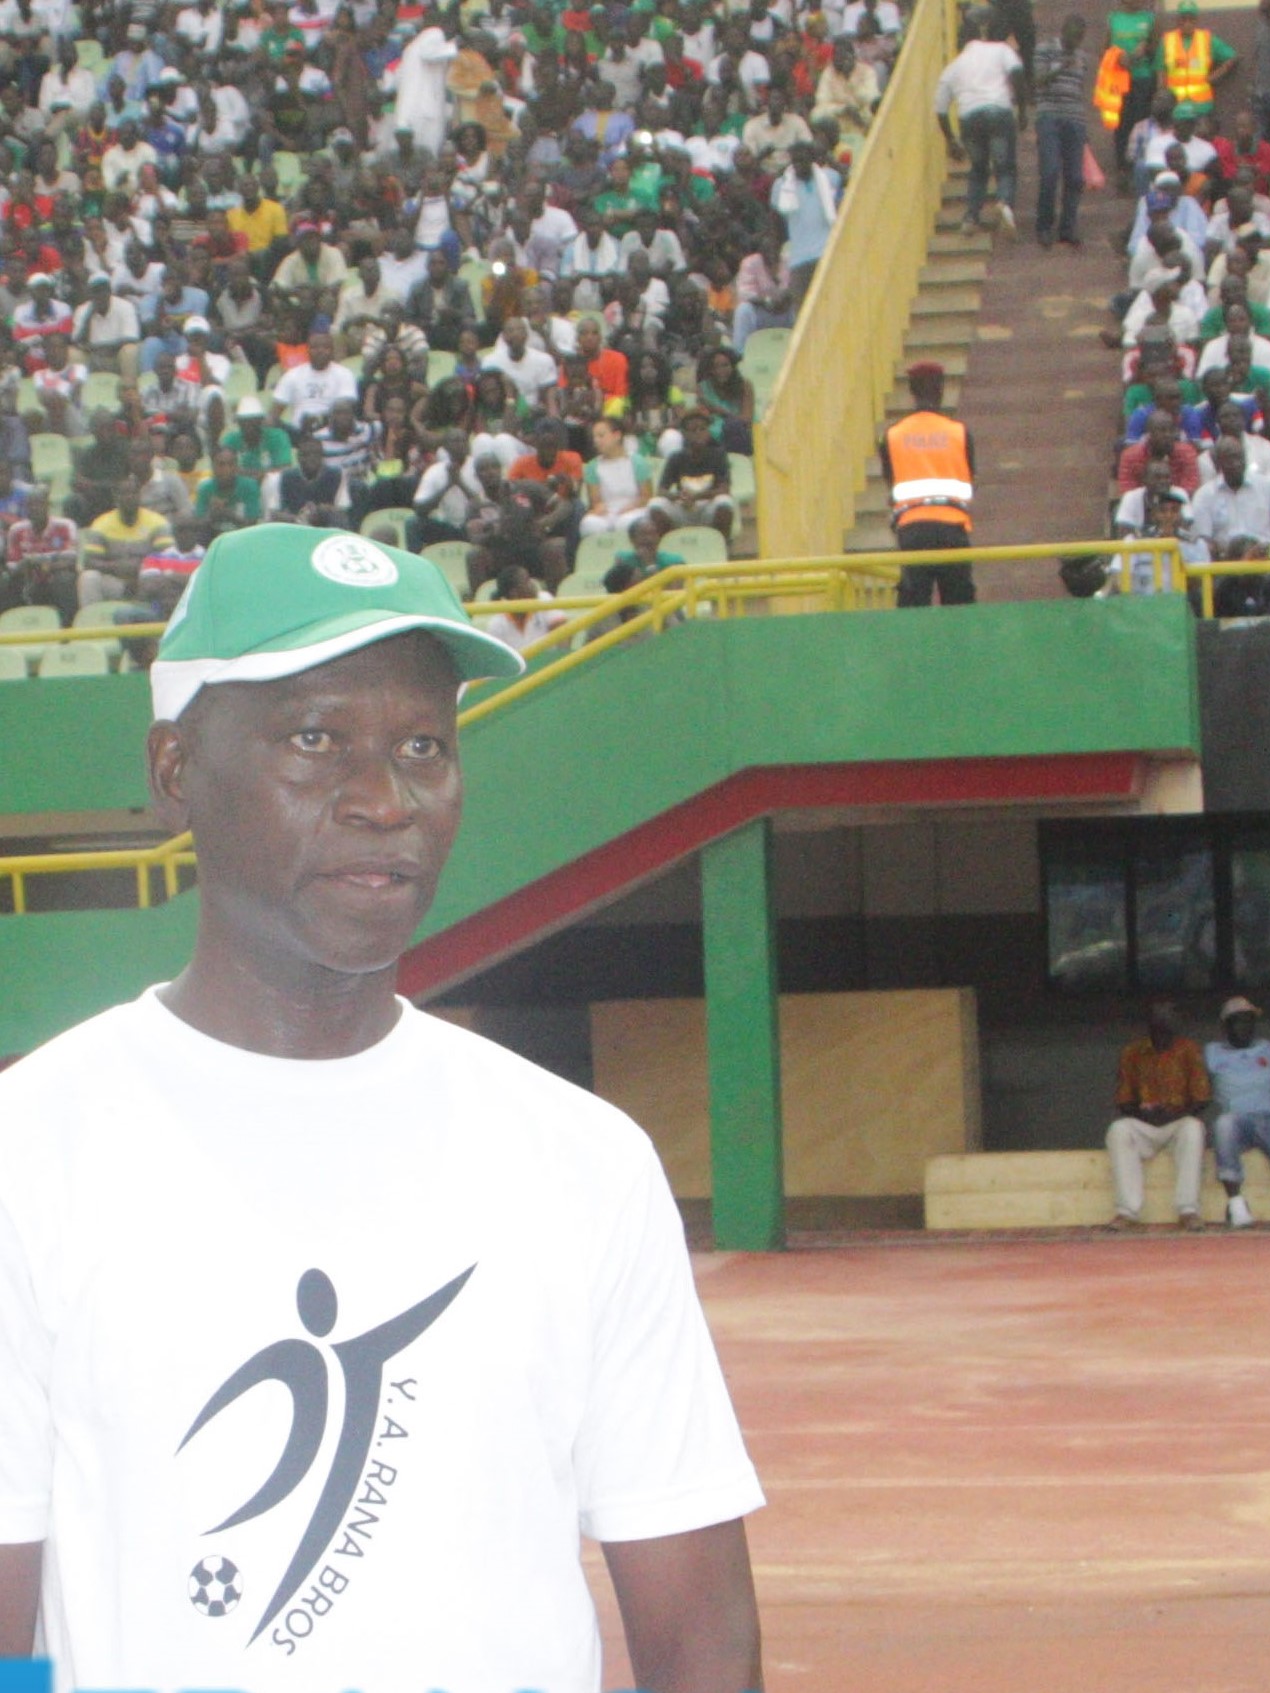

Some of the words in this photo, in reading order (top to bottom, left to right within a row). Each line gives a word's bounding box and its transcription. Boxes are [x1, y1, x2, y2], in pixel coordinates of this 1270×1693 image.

[387, 1378, 418, 1404] Y.
[376, 1415, 409, 1447] A.
[333, 1459, 398, 1558] RANA
[272, 1565, 350, 1656] BROS
